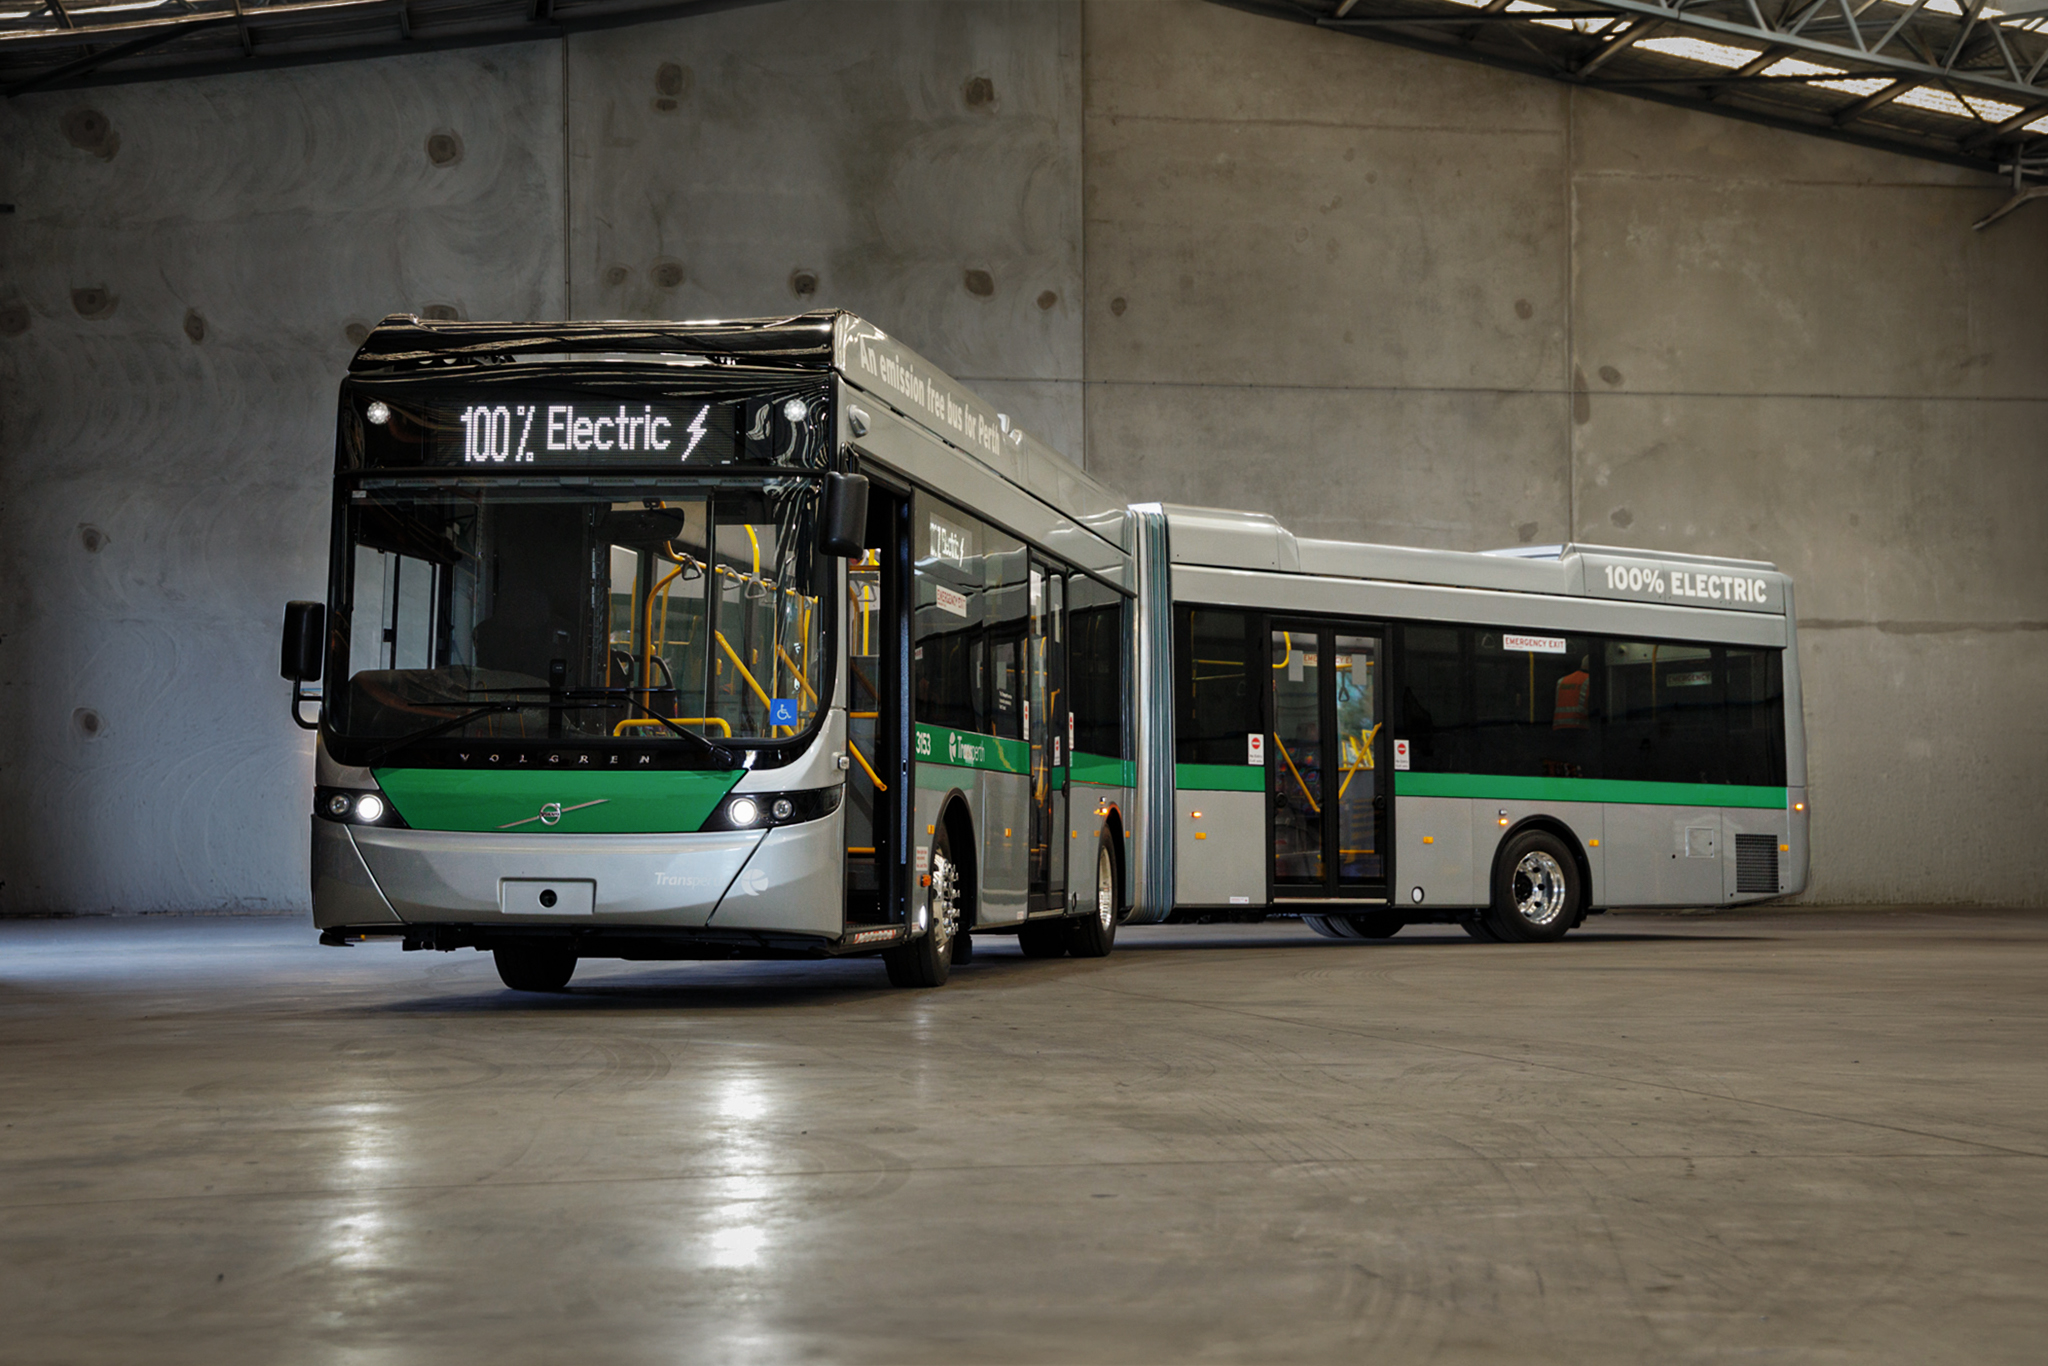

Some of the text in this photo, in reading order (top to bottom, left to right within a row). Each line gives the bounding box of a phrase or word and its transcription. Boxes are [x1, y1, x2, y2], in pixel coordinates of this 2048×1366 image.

[861, 340, 999, 456] An emission free bus for Perth
[460, 405, 671, 461] 100% Electric
[1605, 565, 1767, 603] 100% ELECTRIC
[1505, 637, 1564, 648] EMERGENCY EXIT
[916, 731, 931, 755] 3153
[957, 736, 985, 762] Transperth
[460, 753, 650, 764] VOLGREN
